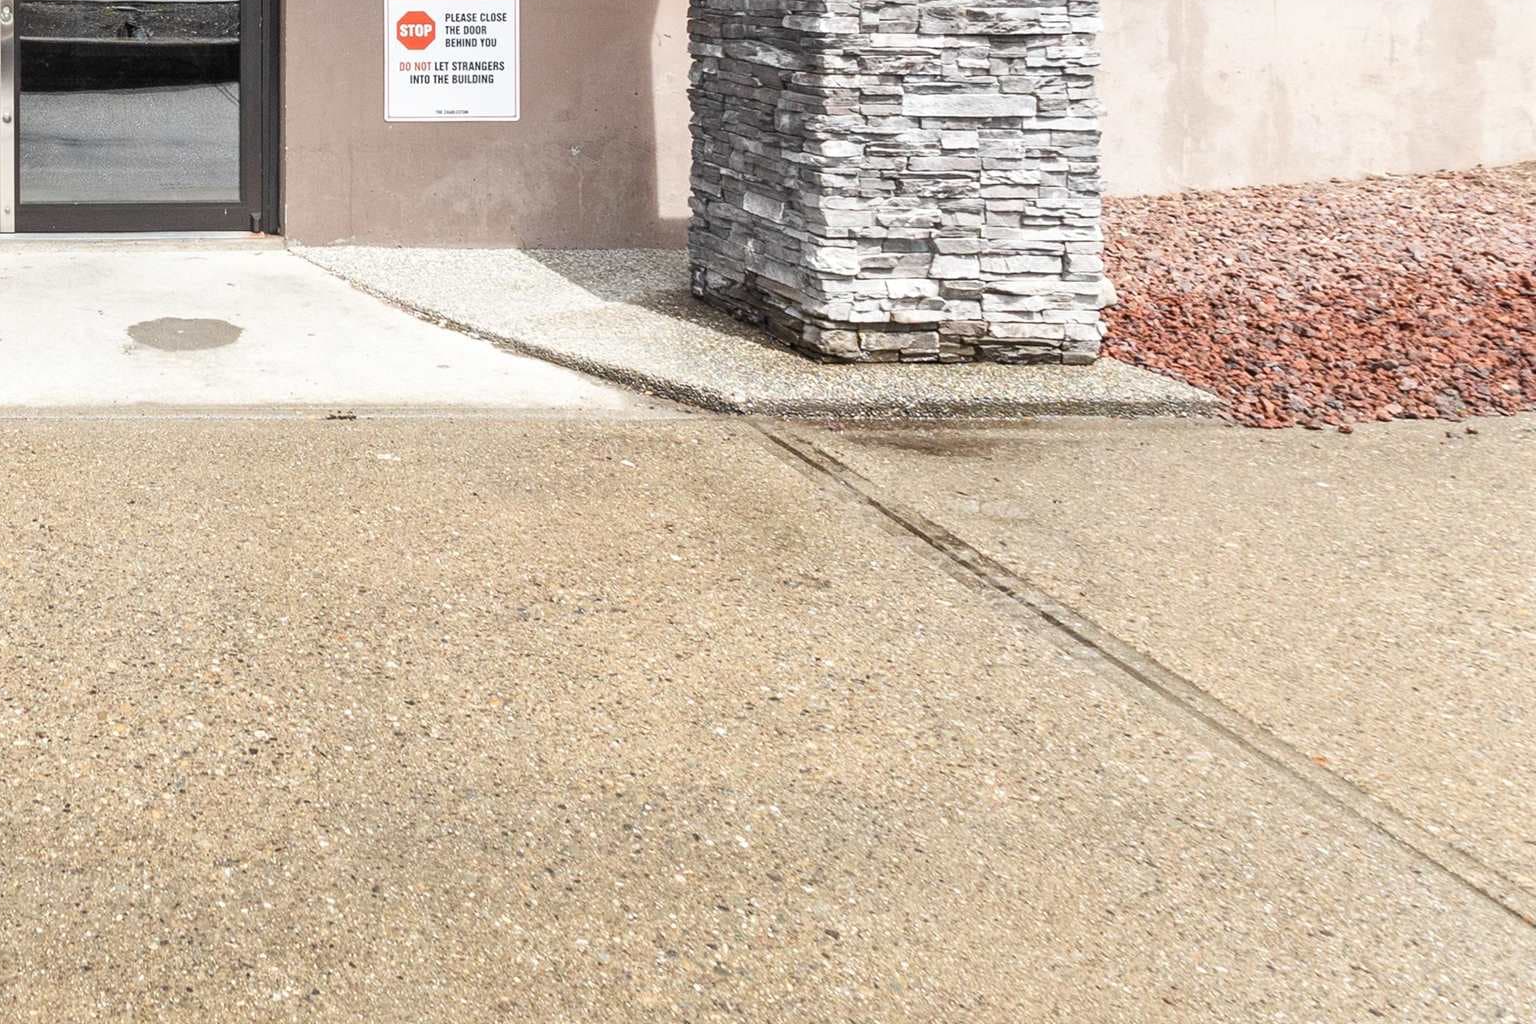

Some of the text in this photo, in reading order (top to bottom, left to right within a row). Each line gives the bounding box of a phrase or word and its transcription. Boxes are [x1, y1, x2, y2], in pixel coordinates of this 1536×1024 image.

[445, 12, 507, 22] PLEASE CLOSE
[399, 24, 433, 37] STOP
[445, 25, 487, 35] THE DOOR
[445, 38, 497, 48] BEHIND YOU
[399, 61, 505, 71] DO NOT LET STRANGERS
[410, 74, 494, 84] INTO THE BUILDING
